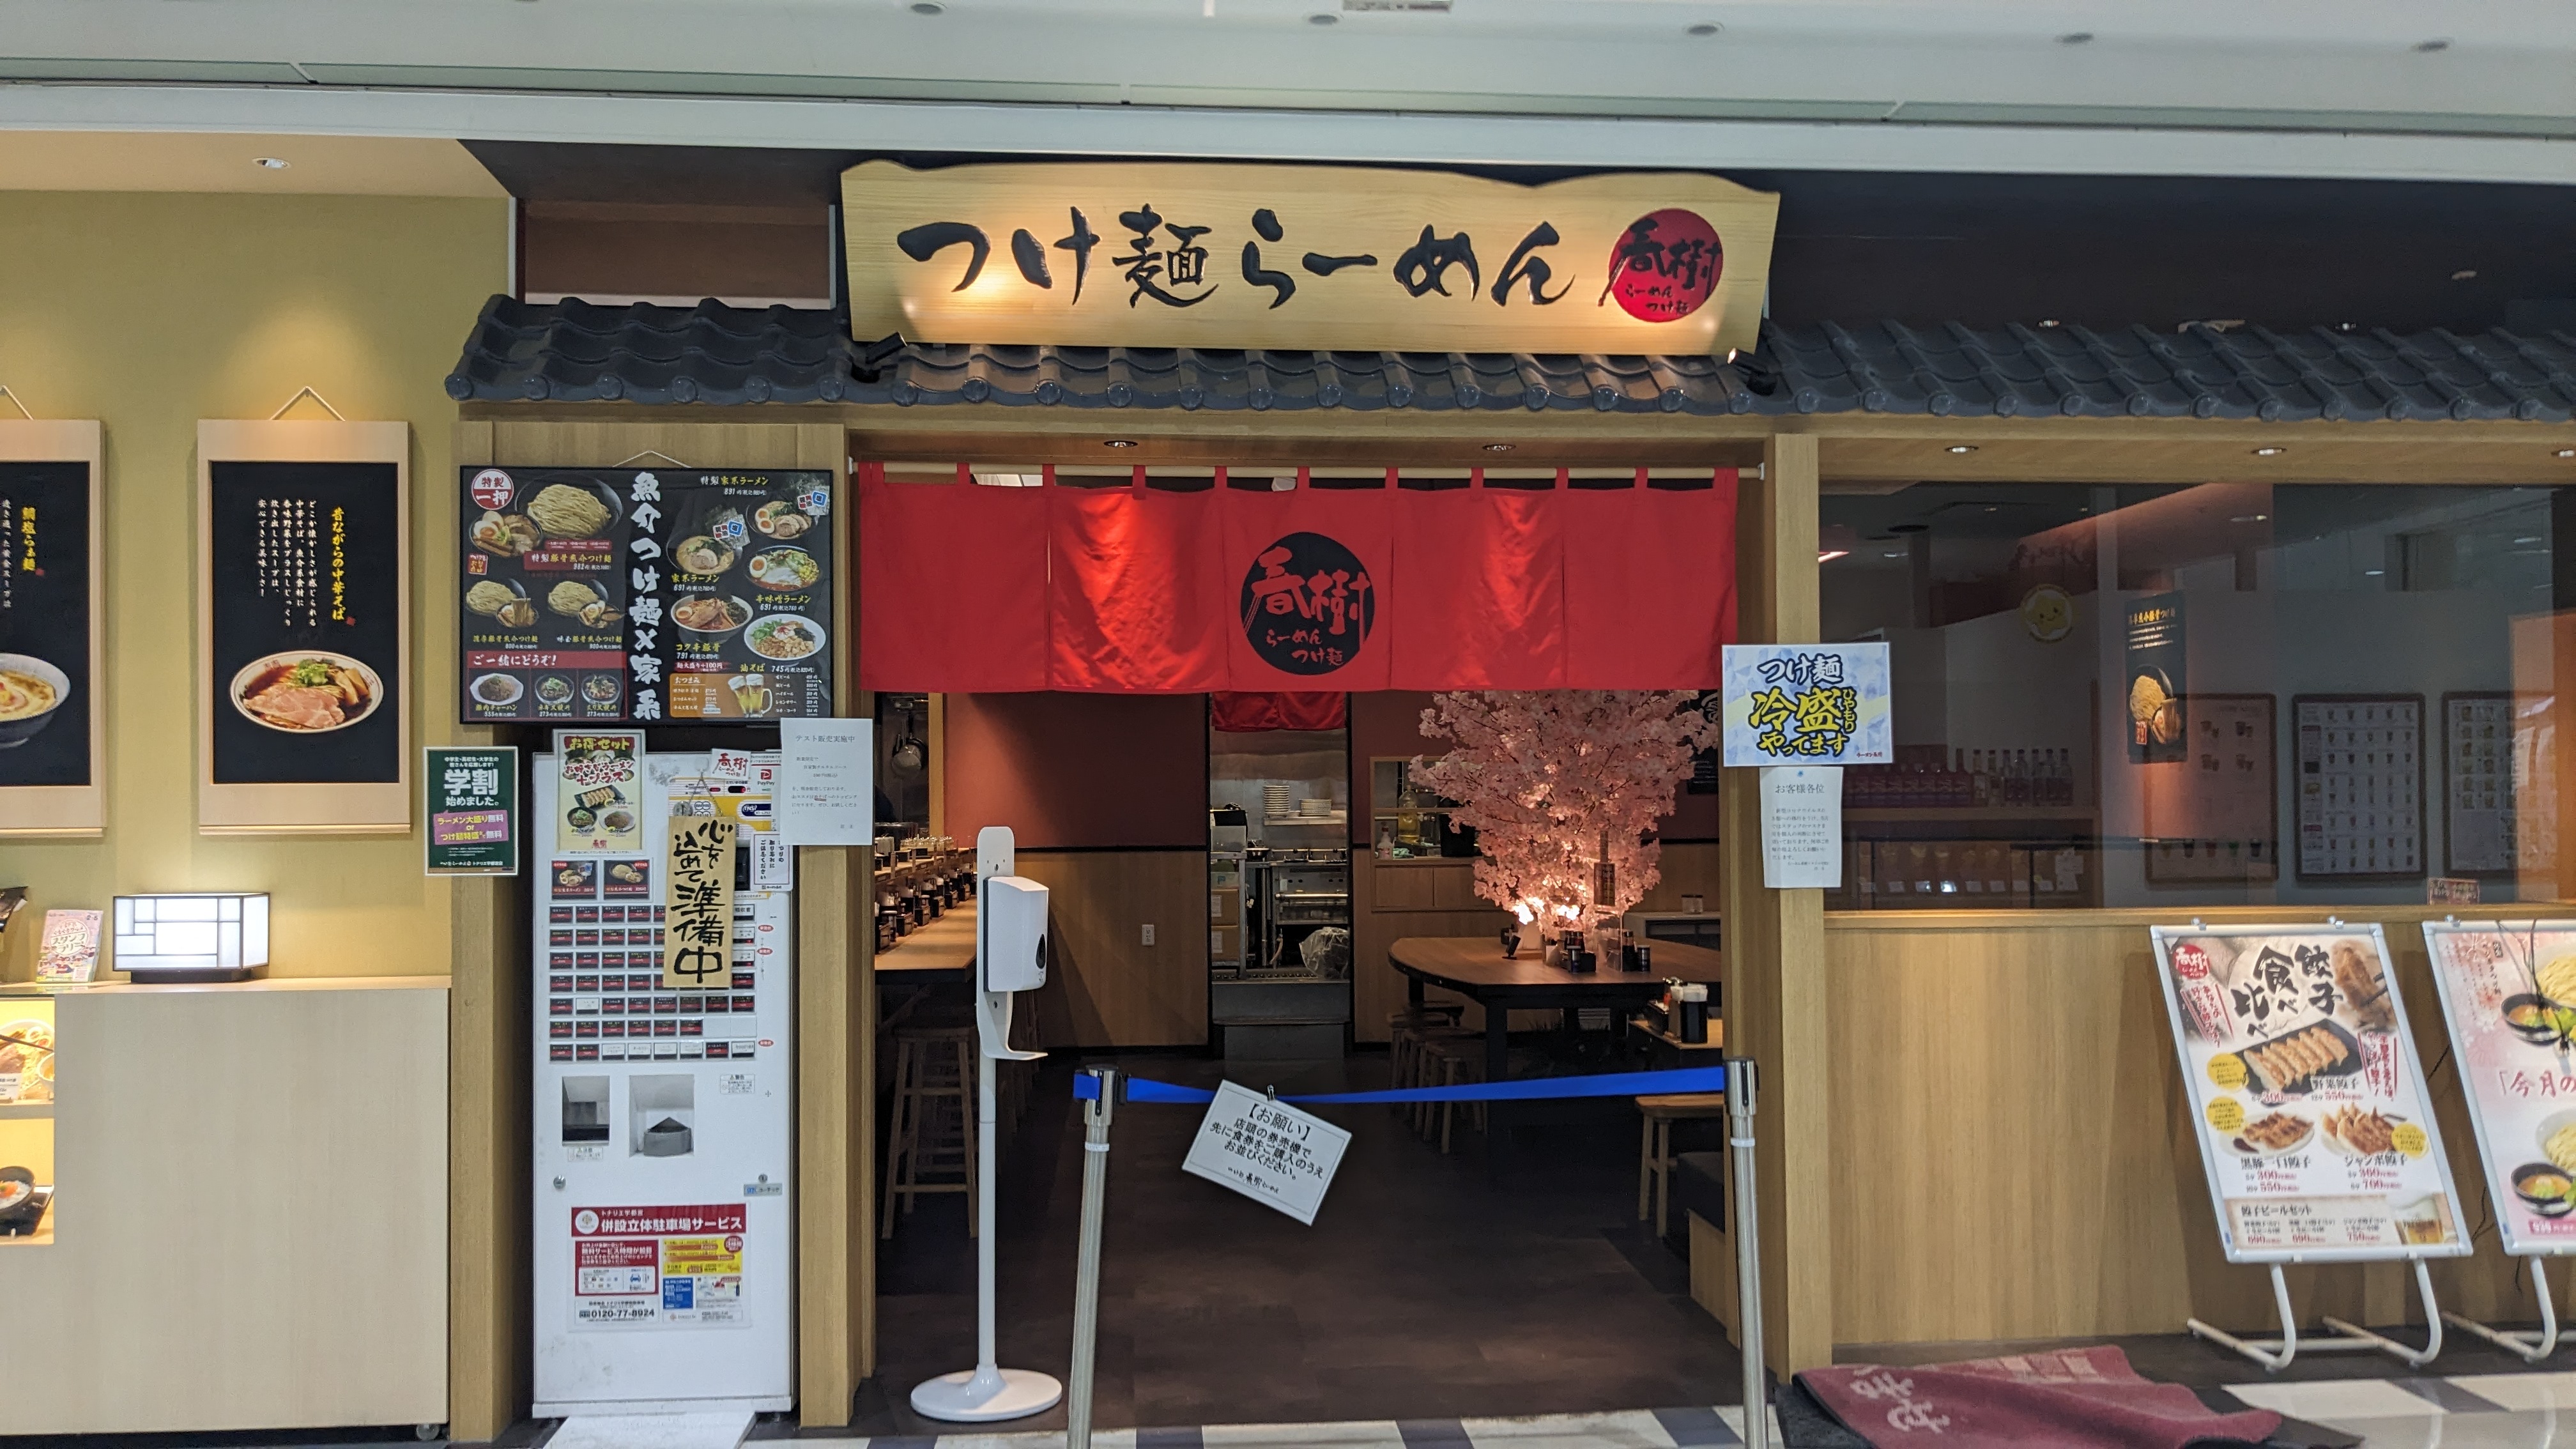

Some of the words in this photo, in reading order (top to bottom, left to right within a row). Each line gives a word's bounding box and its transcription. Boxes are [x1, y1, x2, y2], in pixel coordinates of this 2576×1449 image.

[897, 203, 1575, 309] つけ麺らーめん
[1597, 218, 1721, 307] 春樹
[481, 477, 504, 487] 特製
[476, 490, 509, 505] 一押
[332, 507, 346, 620] 昔ながらの中華そば
[671, 573, 720, 583] 家系ラーメン
[1243, 546, 1371, 653] 春樹
[1266, 629, 1322, 647] らーめん
[740, 663, 765, 672] 油そば
[1292, 647, 1344, 666] つけ麺
[1758, 653, 1843, 684] つけ麺
[1749, 686, 1843, 733] 冷盛
[1842, 687, 1858, 733] ひやもり
[569, 737, 631, 751] お得セット
[1758, 731, 1850, 757] やってます
[443, 769, 498, 795] 学割
[1775, 784, 1825, 794] お客様各位
[446, 796, 499, 806] 始めました。
[671, 878, 726, 984] 準備中
[1209, 1121, 1324, 1180] 先に食券をご購入のうえ
[1234, 1117, 1312, 1159] 店頭の券売機で
[1224, 1140, 1296, 1180] お並びください。
[601, 1216, 742, 1233] 併設立体駐車場サービス
